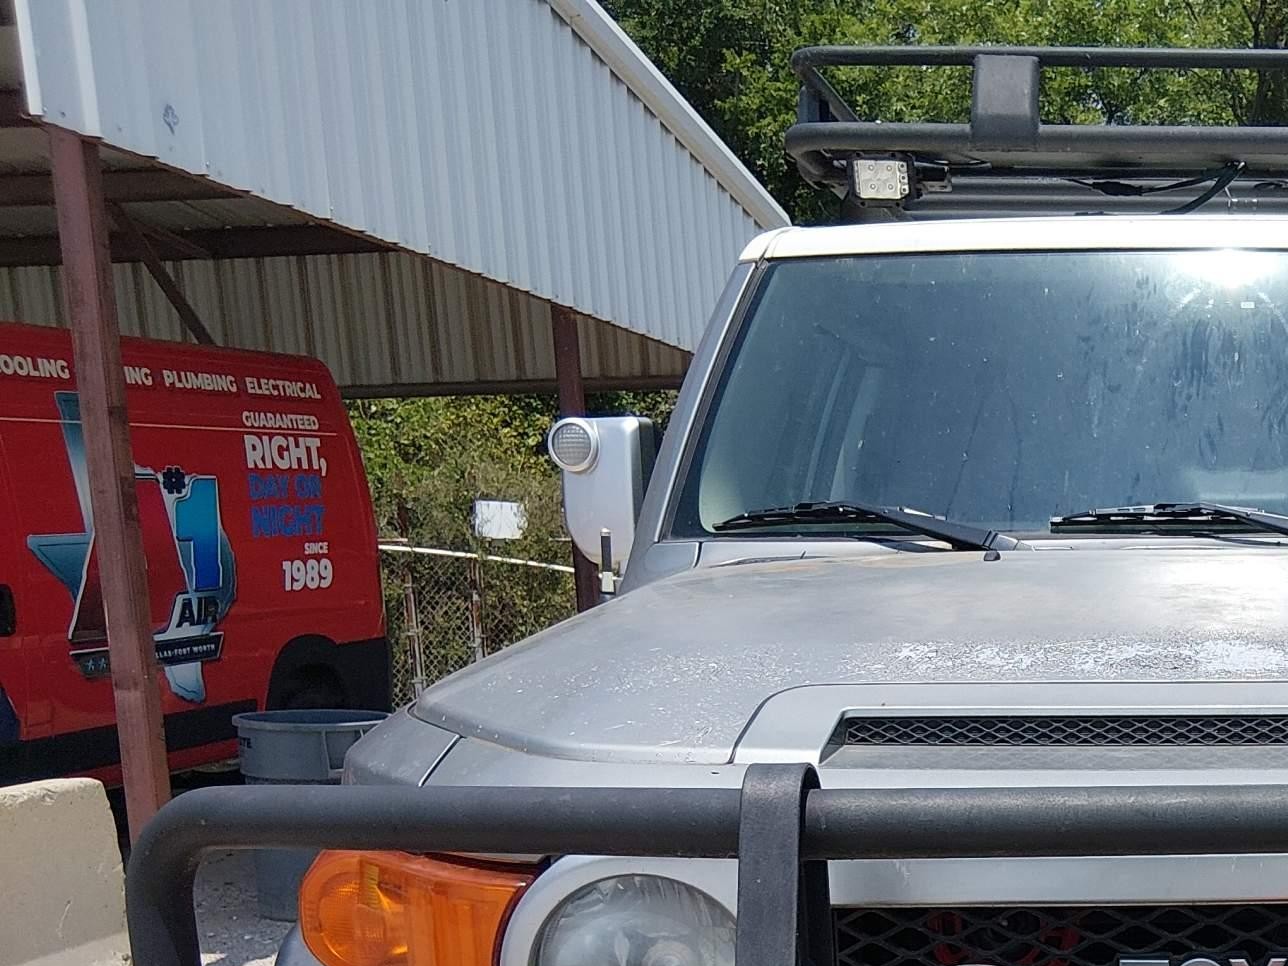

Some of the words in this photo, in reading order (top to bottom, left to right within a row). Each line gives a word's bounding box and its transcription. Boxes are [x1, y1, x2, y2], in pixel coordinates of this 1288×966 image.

[0, 354, 70, 379] OOLING
[163, 370, 237, 392] PLUMBING
[245, 377, 321, 399] ELECTRICAL
[242, 411, 319, 430] GUARANTEED
[244, 435, 327, 476] RIGHT,
[249, 473, 289, 499] DAY
[295, 474, 322, 498] OR
[251, 504, 325, 538] NIGHT
[304, 542, 328, 554] SINCE
[282, 558, 333, 591] 1989
[175, 596, 219, 628] AIR
[192, 643, 215, 654] WORTH
